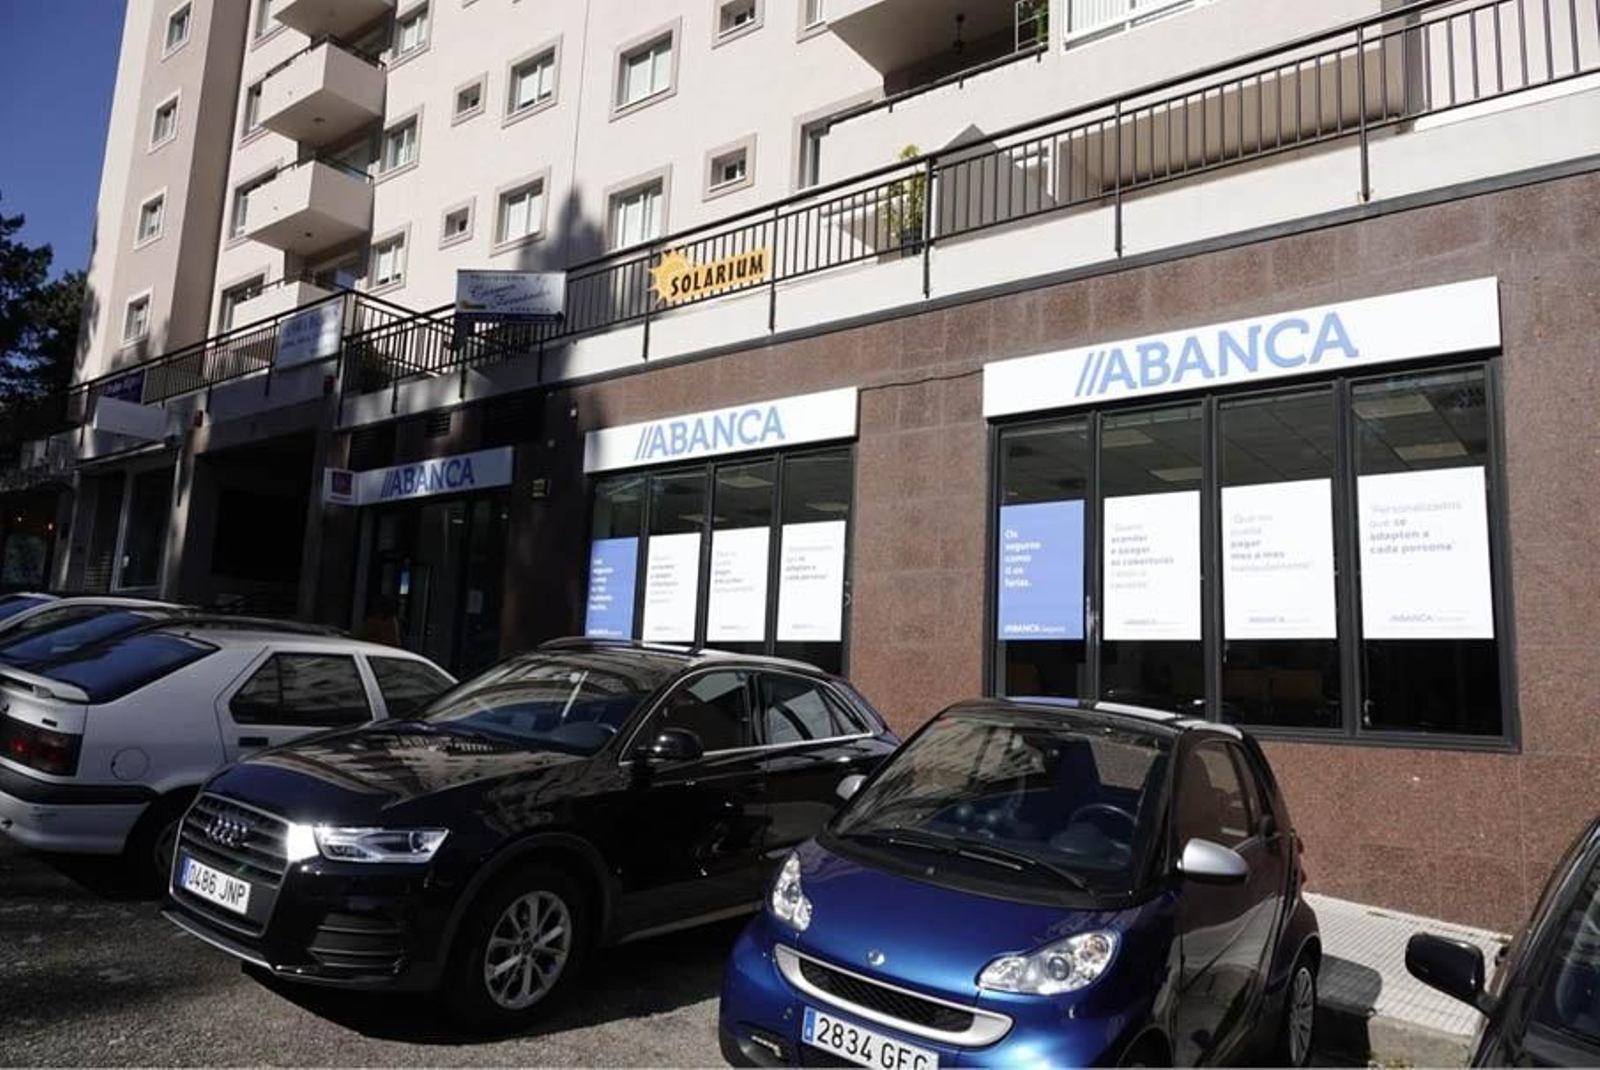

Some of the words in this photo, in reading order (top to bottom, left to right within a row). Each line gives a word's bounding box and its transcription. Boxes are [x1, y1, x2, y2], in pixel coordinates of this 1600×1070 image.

[670, 254, 764, 297] SOLARIUM
[189, 863, 217, 896] 0486
[218, 880, 247, 906] JNP
[816, 1017, 873, 1062] 2834
